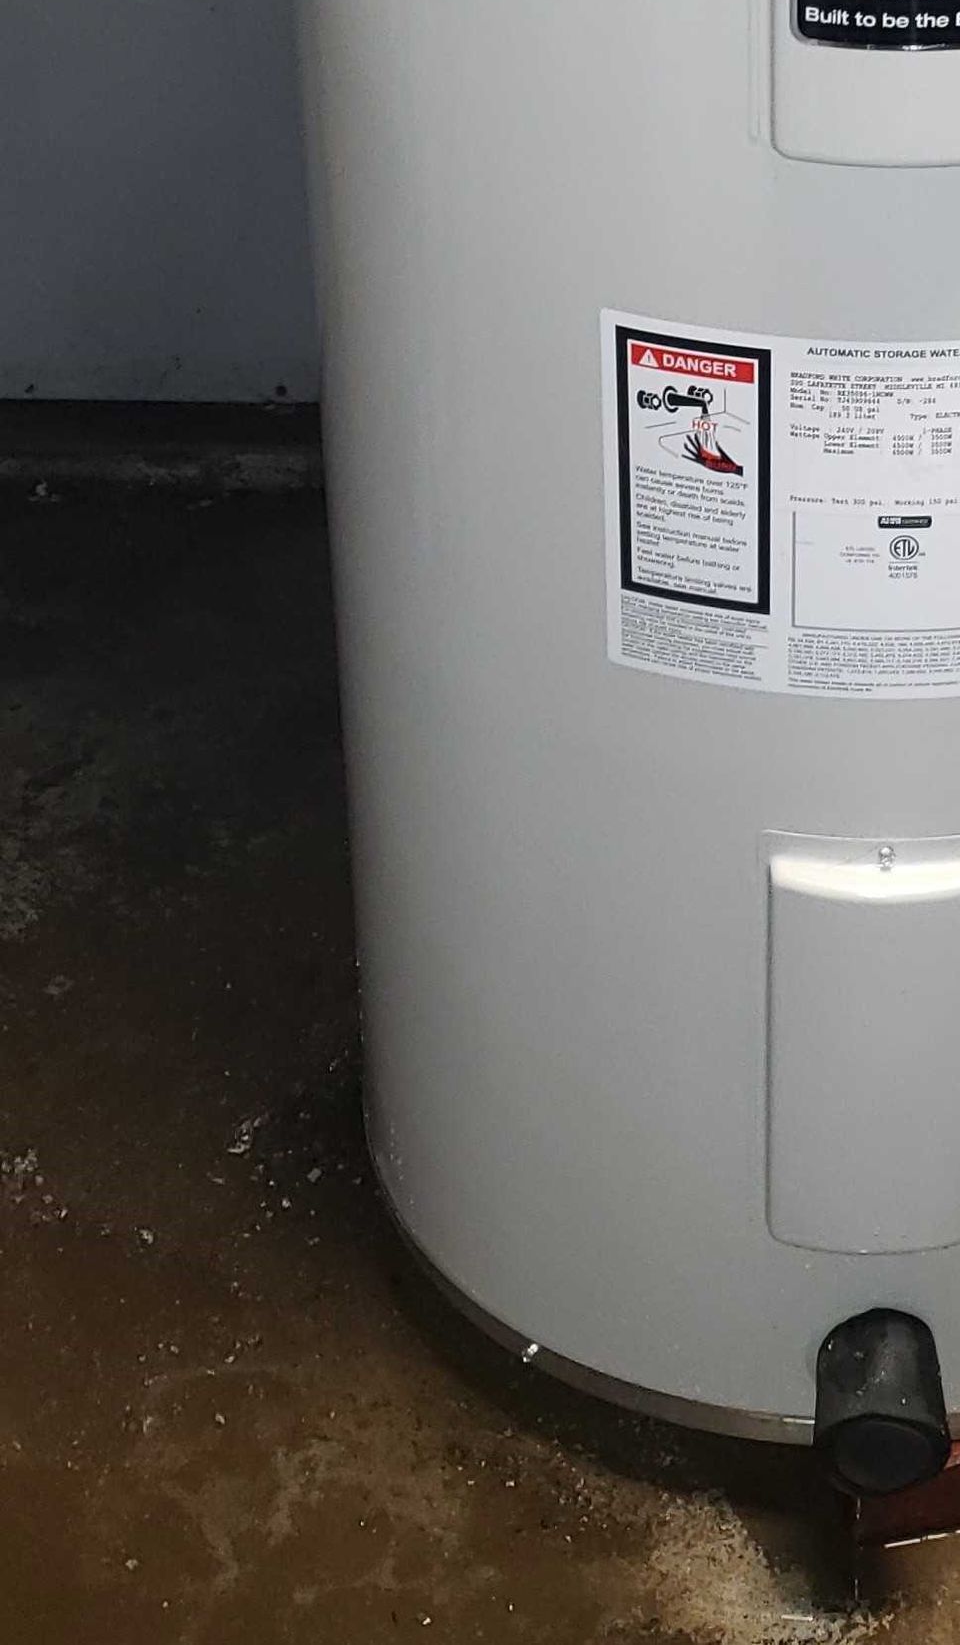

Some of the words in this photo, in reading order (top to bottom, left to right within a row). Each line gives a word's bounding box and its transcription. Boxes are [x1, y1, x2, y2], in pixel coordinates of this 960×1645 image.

[805, 6, 850, 25] Built
[854, 11, 876, 27] to
[882, 12, 909, 28] be
[915, 12, 949, 28] the
[807, 346, 870, 359] AUTOMATIC
[874, 350, 927, 359] STORAGE
[663, 353, 737, 378] DANGER
[692, 420, 719, 430] HOT
[636, 465, 656, 475] Water
[659, 470, 704, 484] temperature
[701, 493, 718, 502] from
[895, 499, 925, 507] Working
[945, 497, 958, 505] psi
[659, 505, 685, 518] highest
[713, 516, 733, 526] being
[704, 505, 718, 513] and
[720, 508, 746, 520] elderly
[663, 534, 707, 548] temperature
[895, 539, 915, 558] ETL
